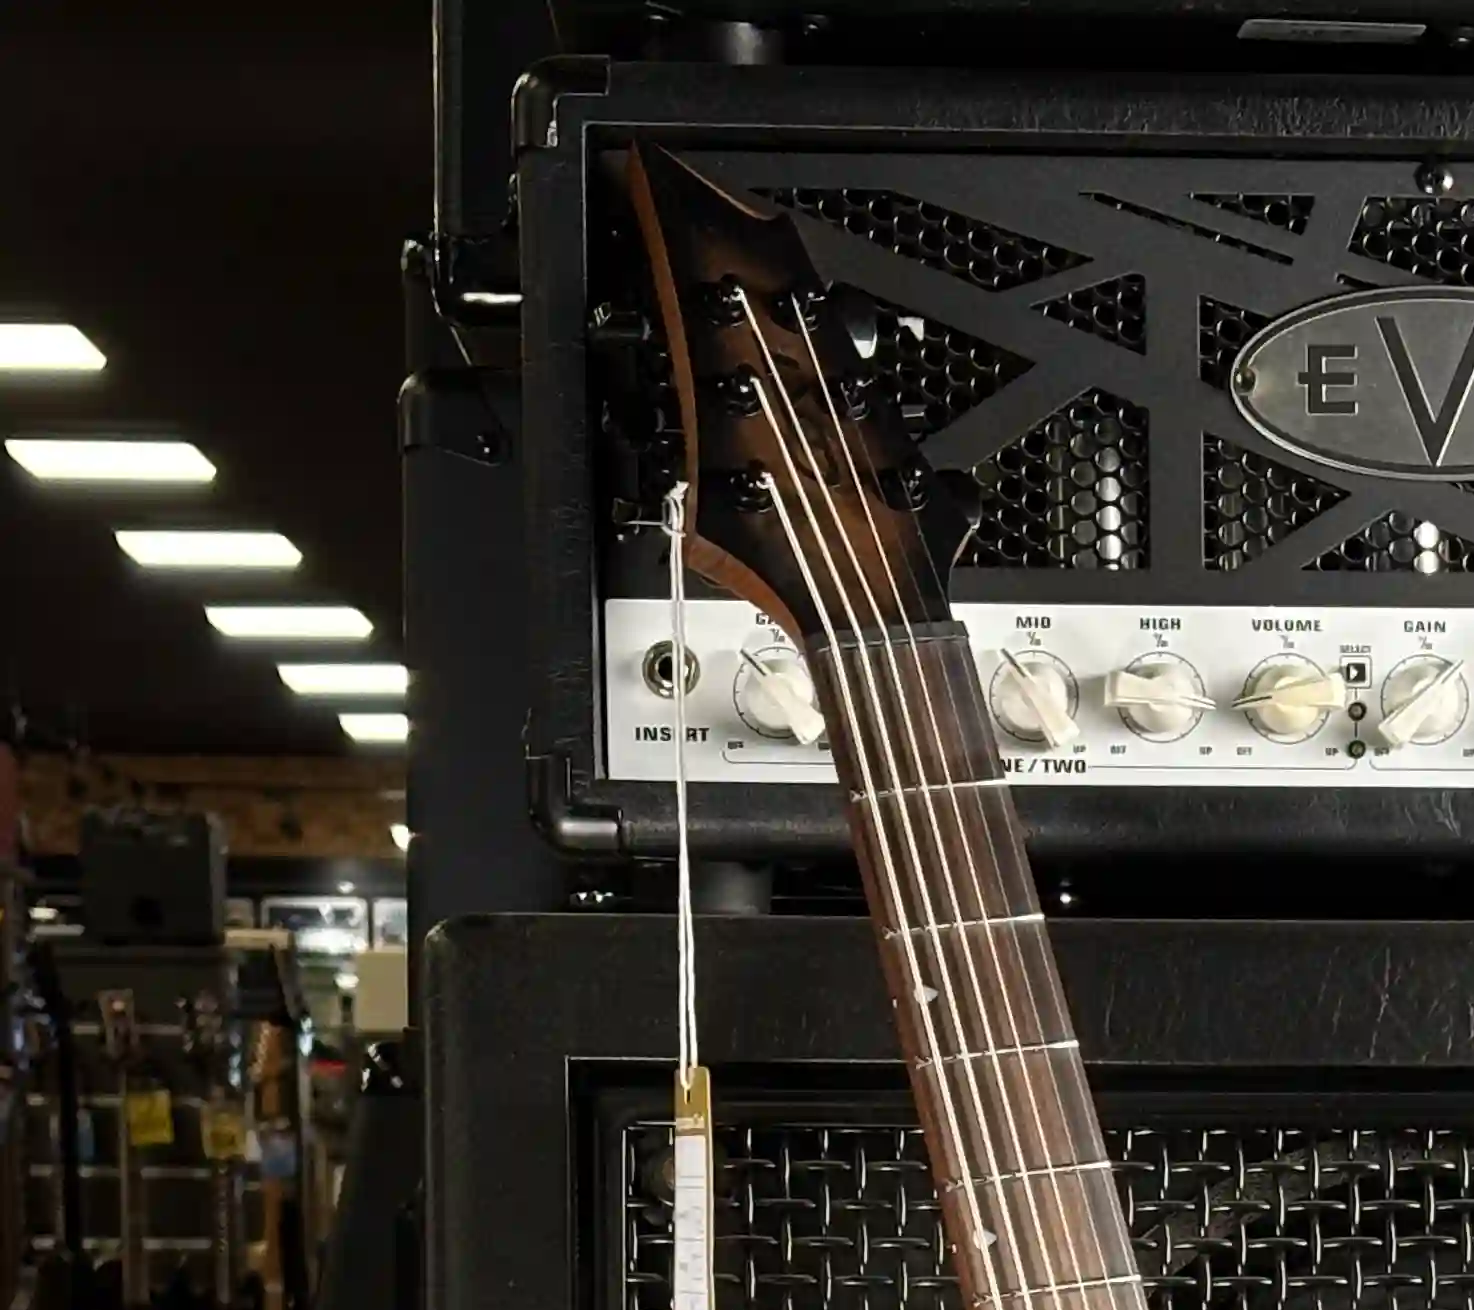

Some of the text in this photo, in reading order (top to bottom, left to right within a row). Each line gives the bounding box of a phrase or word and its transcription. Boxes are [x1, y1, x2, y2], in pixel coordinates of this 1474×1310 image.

[1015, 615, 1052, 630] MID
[1139, 617, 1182, 631] HIGH
[1251, 619, 1322, 633] VOLUME
[1403, 620, 1447, 634] GAIN
[635, 726, 711, 743] INSRT
[1000, 758, 1087, 774] NE/TWO
